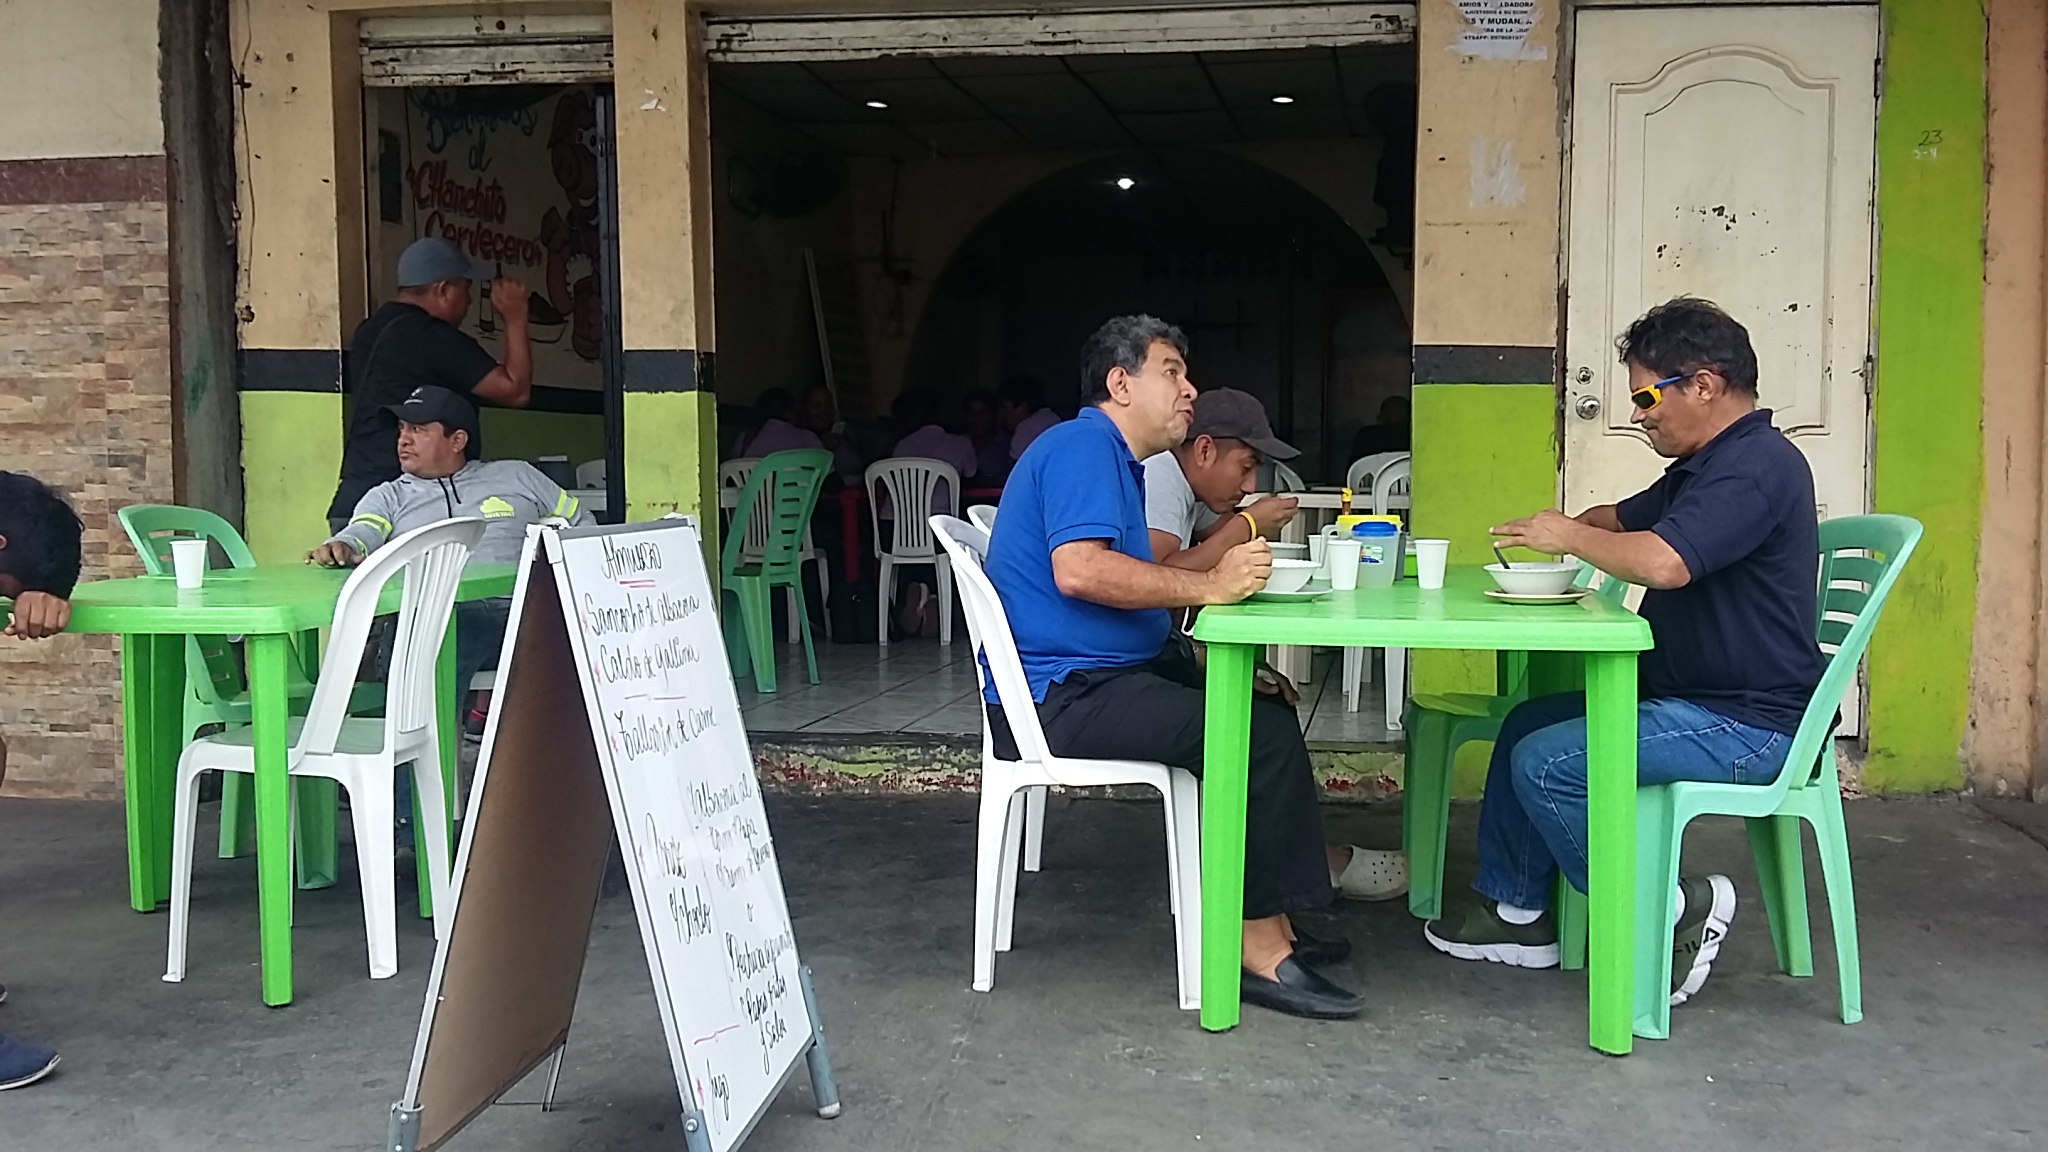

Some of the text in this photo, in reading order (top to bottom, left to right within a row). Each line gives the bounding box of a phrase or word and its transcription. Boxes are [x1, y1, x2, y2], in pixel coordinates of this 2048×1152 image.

[1918, 129, 1943, 147] 23
[584, 592, 645, 637] Sancocho
[600, 644, 642, 684] Caldo
